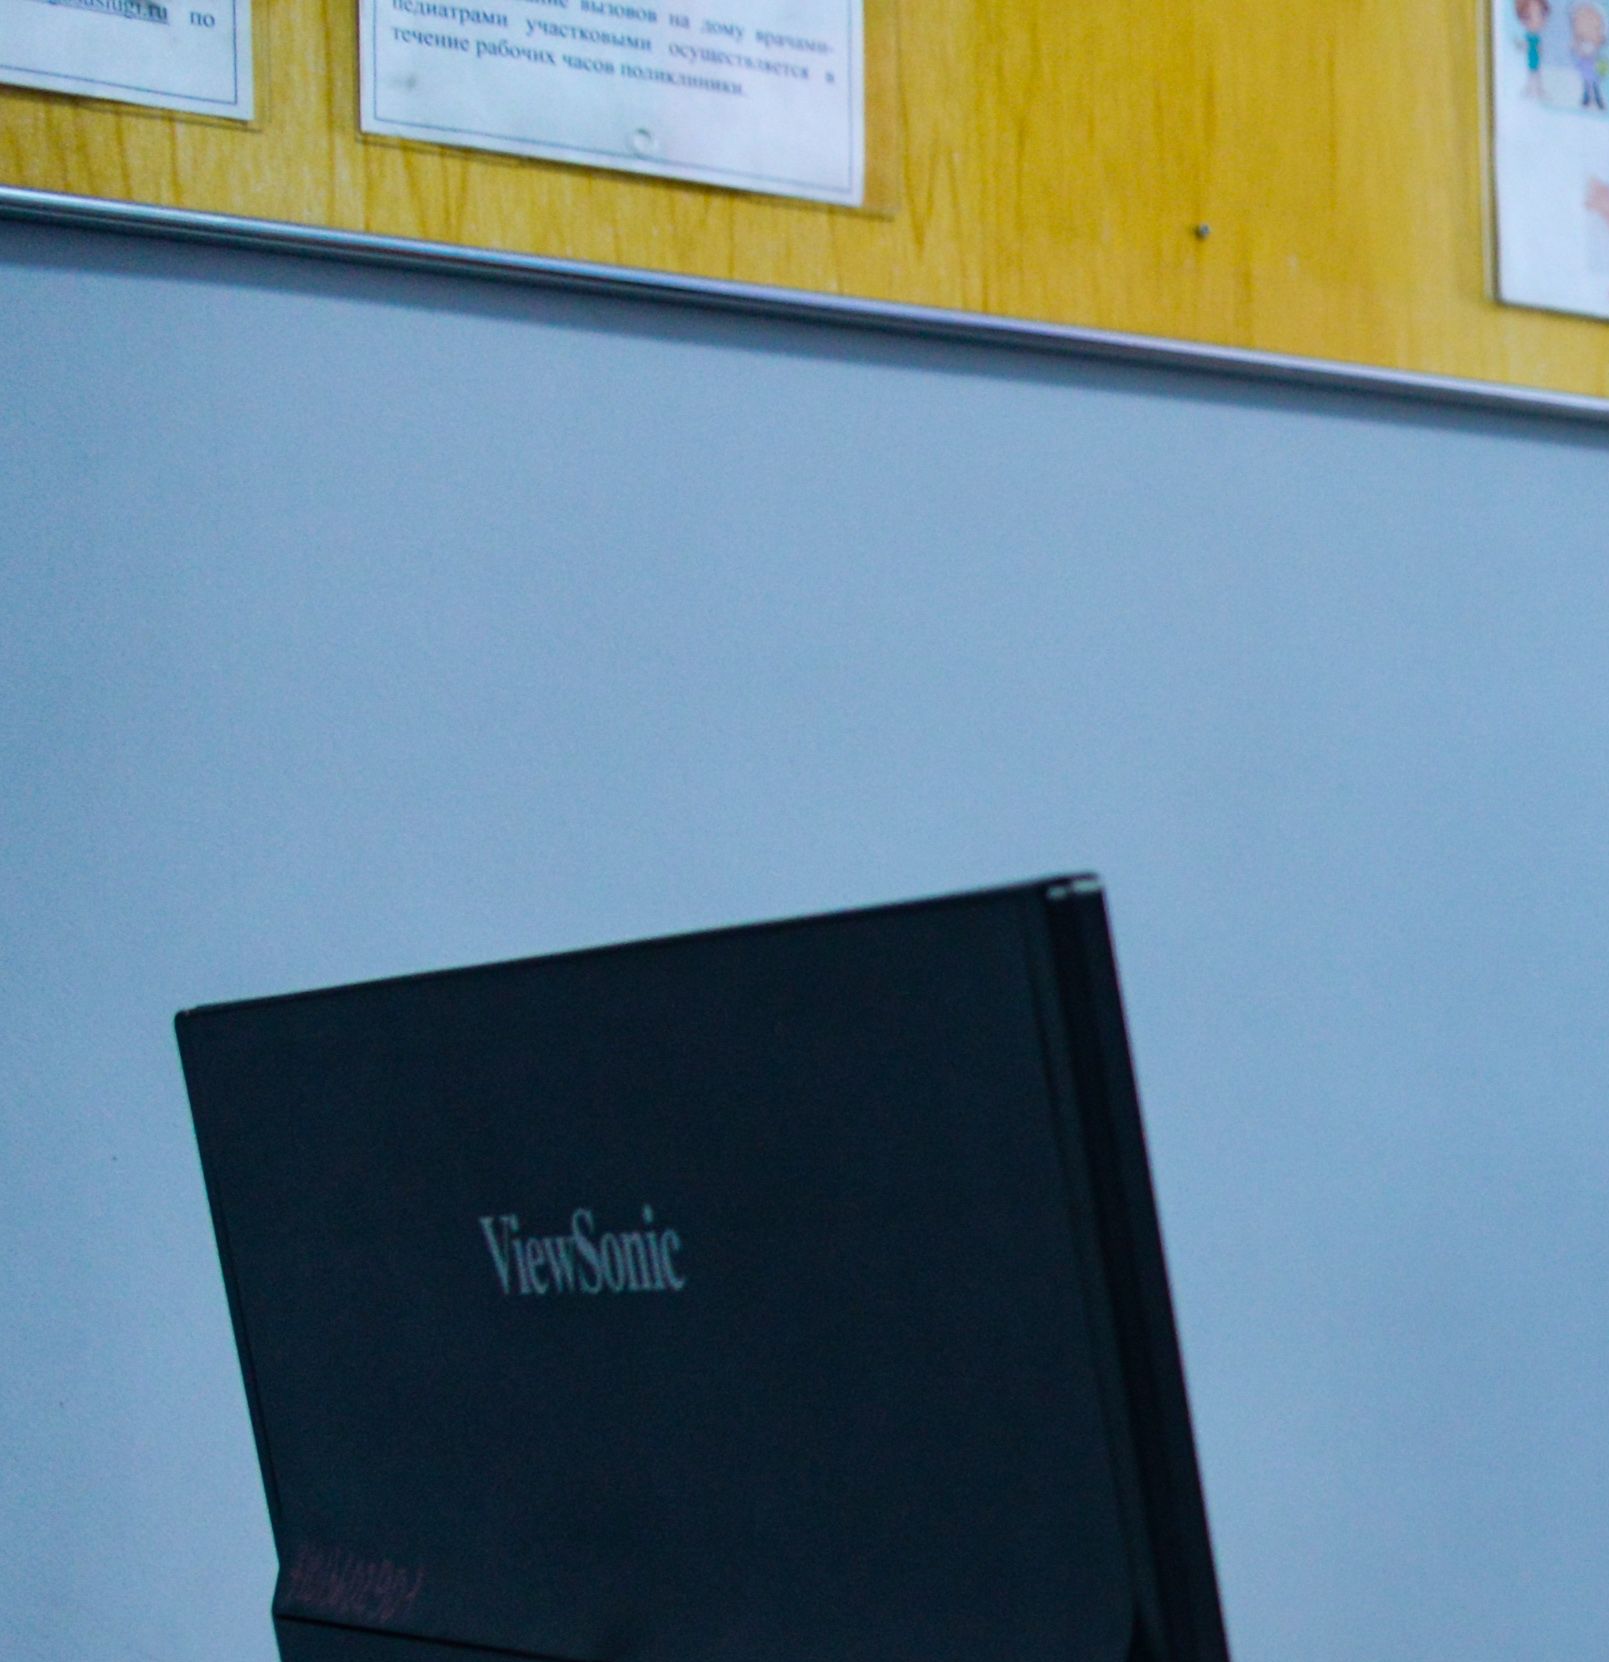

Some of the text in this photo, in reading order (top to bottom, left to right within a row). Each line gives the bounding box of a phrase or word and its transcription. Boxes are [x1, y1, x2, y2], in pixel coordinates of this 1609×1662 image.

[190, 11, 216, 28] по
[526, 18, 652, 51] участковыми
[669, 13, 691, 29] на
[701, 19, 744, 43] дому
[392, 27, 470, 51] течение
[475, 37, 556, 67] рабочих
[562, 54, 615, 75] часов
[479, 1204, 686, 1295] ViewSonic
